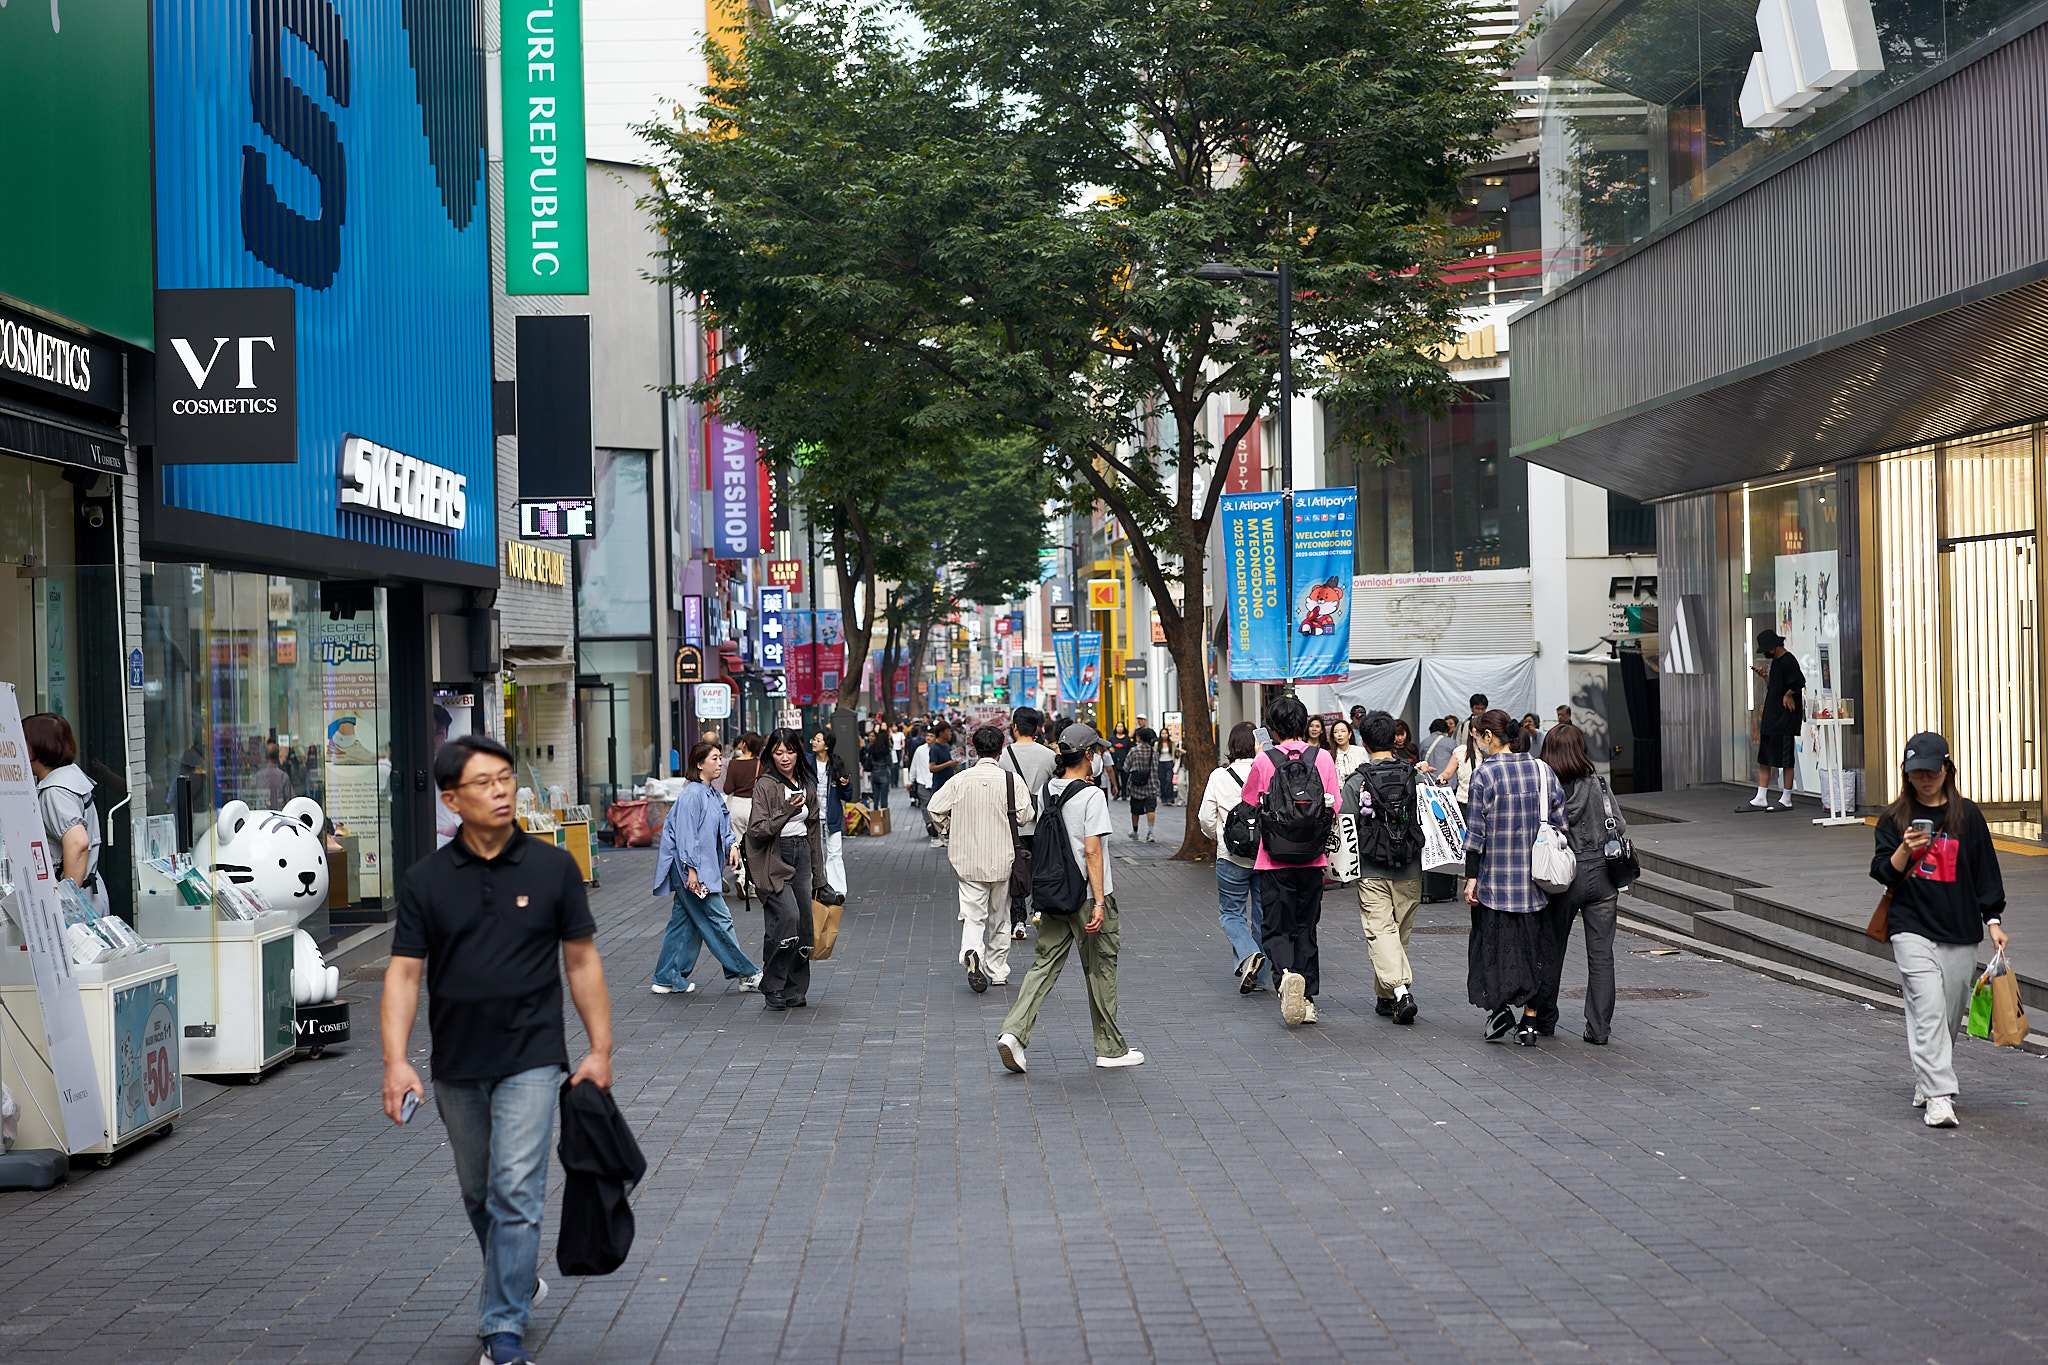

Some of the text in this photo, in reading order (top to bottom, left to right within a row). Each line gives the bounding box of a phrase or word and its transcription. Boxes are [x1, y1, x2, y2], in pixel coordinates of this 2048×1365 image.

[526, 0, 560, 276] URE REPUBLIC
[170, 336, 275, 390] VT
[172, 398, 277, 415] COSMETICS
[90, 444, 121, 468] VT COSMETICS
[1237, 439, 1249, 491] SUPY
[341, 438, 467, 530] SKECHERS
[722, 421, 748, 553] VAPESHOP
[1295, 529, 1352, 540] WELCOME TO
[1295, 540, 1352, 549] MYEONGDONG
[507, 541, 566, 586] NATURE REPUBLIC
[770, 563, 799, 573] JUNO
[1247, 518, 1264, 619] MYEONGDONG
[1261, 517, 1277, 607] WELCOME TO
[773, 571, 797, 580] HAIR
[1352, 578, 1393, 588] ownload
[1417, 576, 1444, 584] MOMENT
[1448, 575, 1473, 583] #SEOUL
[1233, 519, 1250, 651] 2025 GOLDEN OCTOBER
[1609, 576, 1657, 598] FR
[764, 643, 783, 664] 약
[133, 668, 141, 683] 28
[323, 675, 357, 683] Bending
[323, 689, 360, 697] Touching
[462, 696, 473, 705] B1
[329, 701, 347, 710] Step
[0, 741, 17, 758] AND
[295, 1019, 318, 1035] VT
